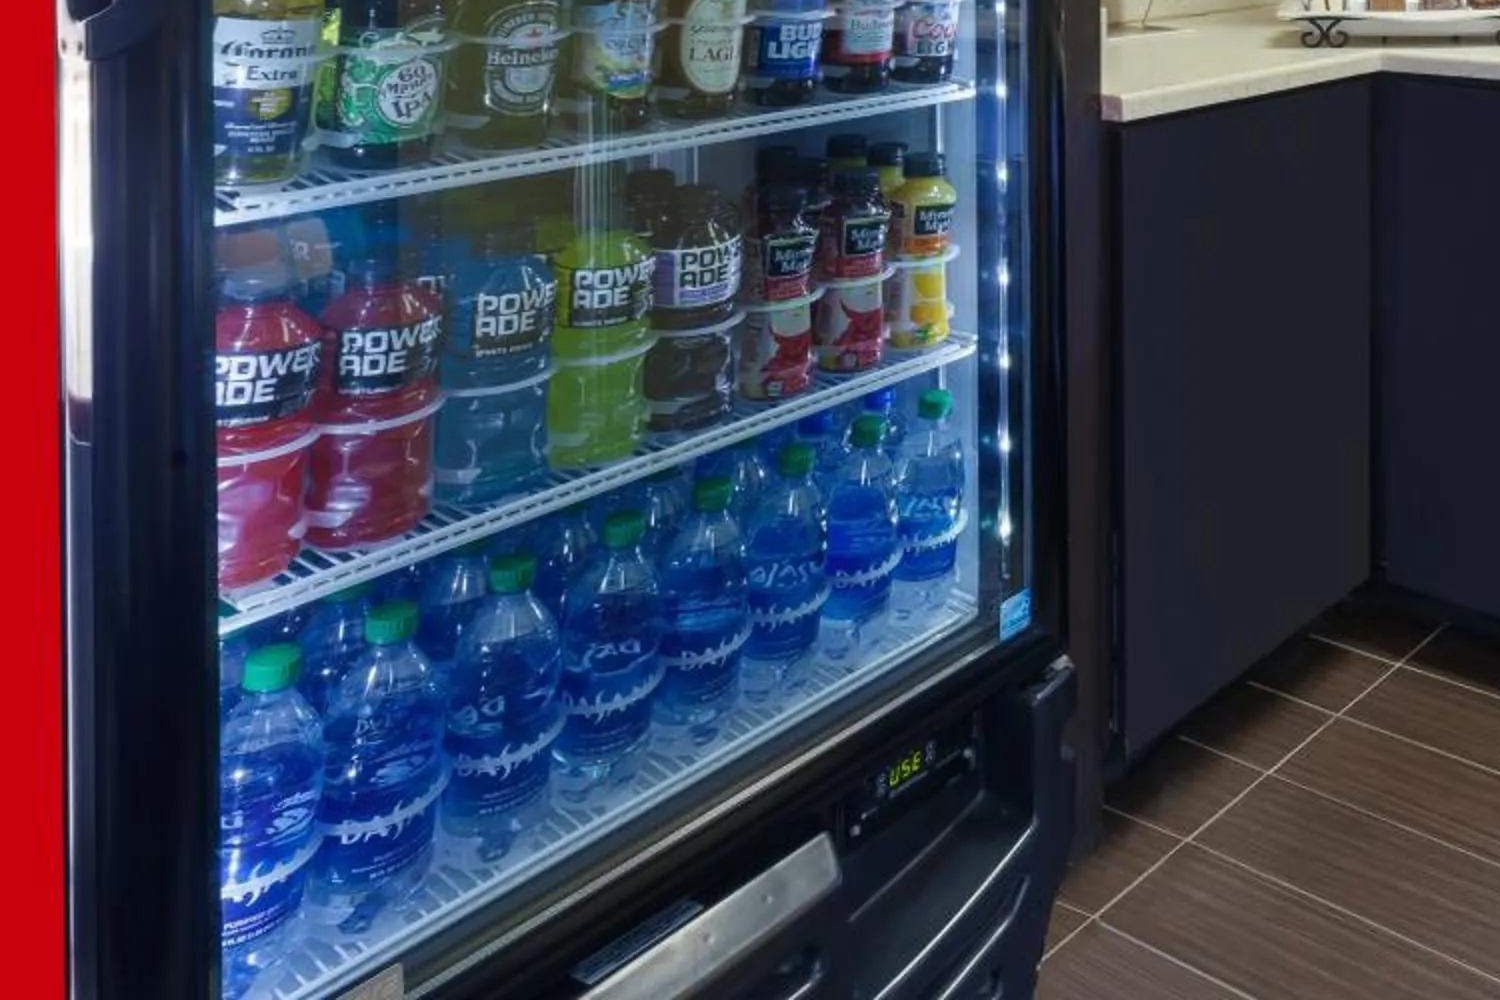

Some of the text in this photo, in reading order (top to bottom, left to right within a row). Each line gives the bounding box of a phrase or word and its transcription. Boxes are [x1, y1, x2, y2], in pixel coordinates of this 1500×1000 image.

[246, 65, 299, 82] Extra
[679, 264, 729, 289] ADE
[573, 284, 632, 310] ADE
[474, 310, 535, 339] ADE
[337, 350, 408, 379] ADE
[889, 750, 922, 787] USE
